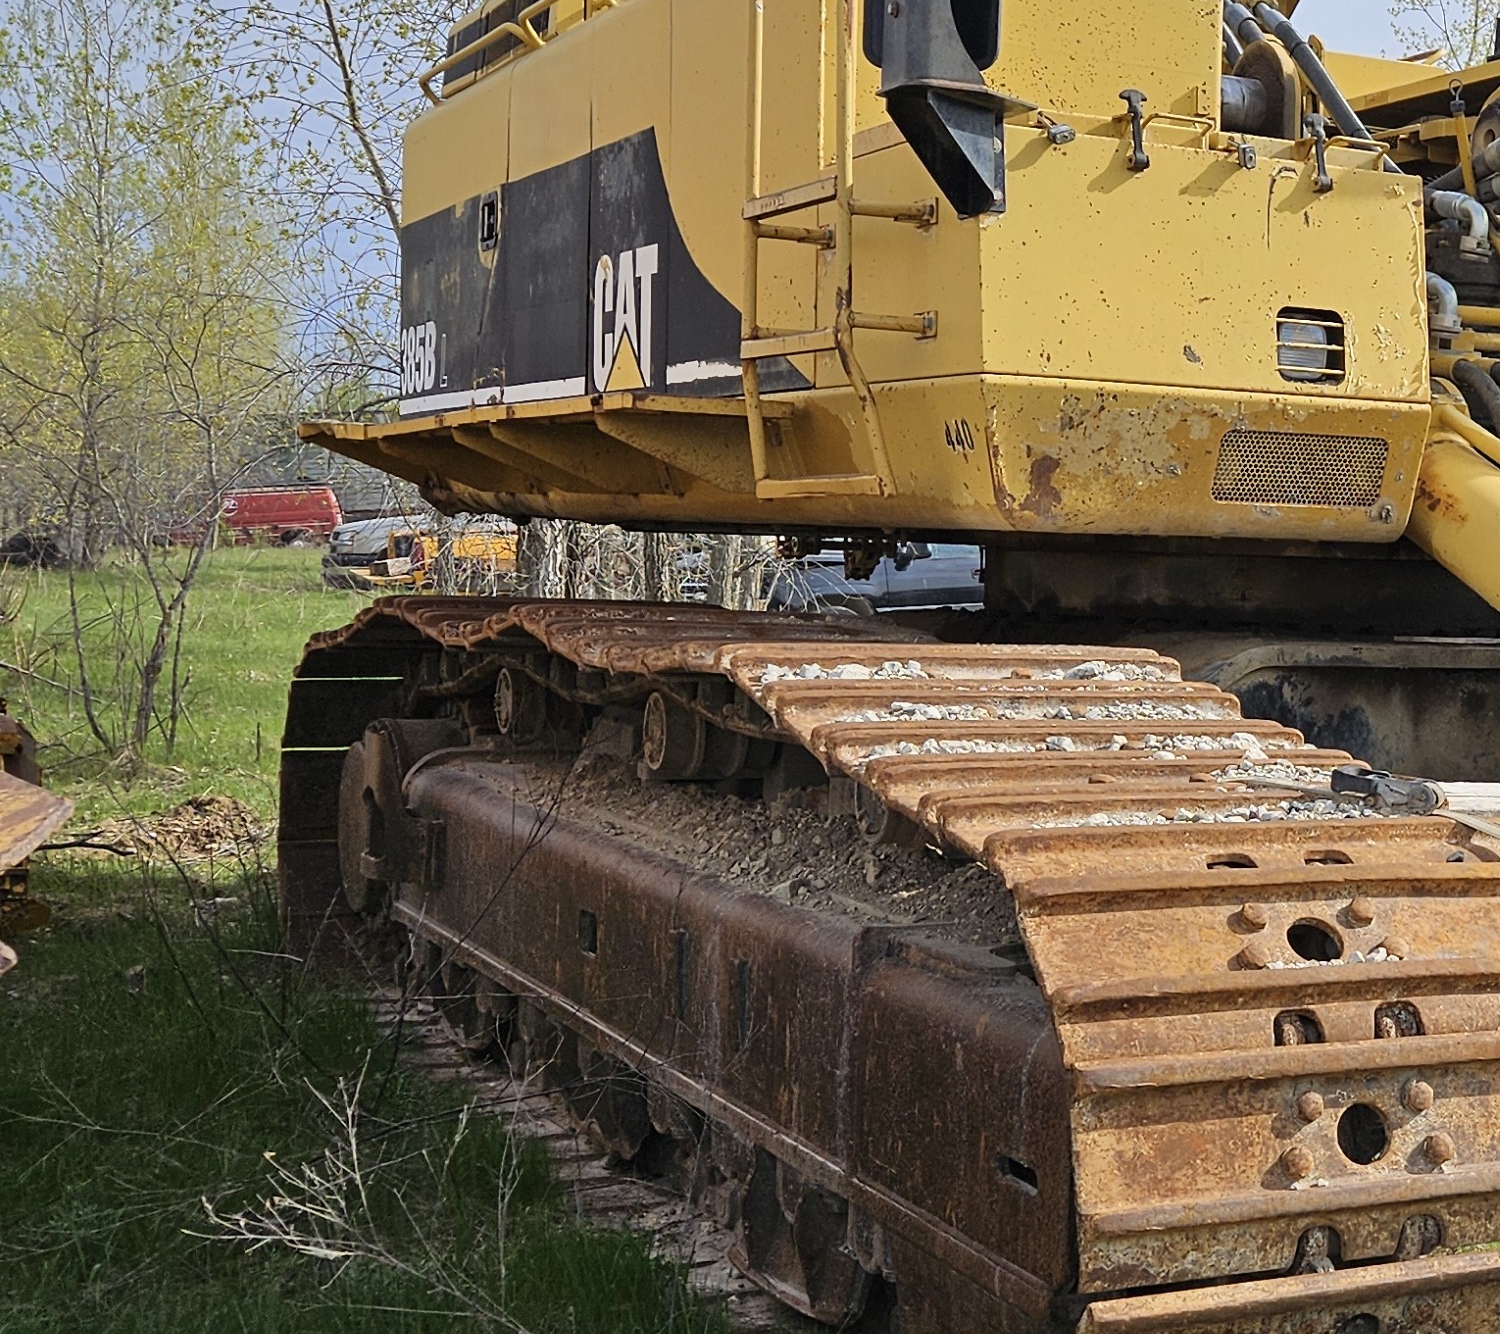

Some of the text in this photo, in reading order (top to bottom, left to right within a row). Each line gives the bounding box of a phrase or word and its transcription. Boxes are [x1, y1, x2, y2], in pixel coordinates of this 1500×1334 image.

[593, 243, 659, 393] CAT
[401, 320, 437, 397] 385B
[944, 418, 975, 452] 440
